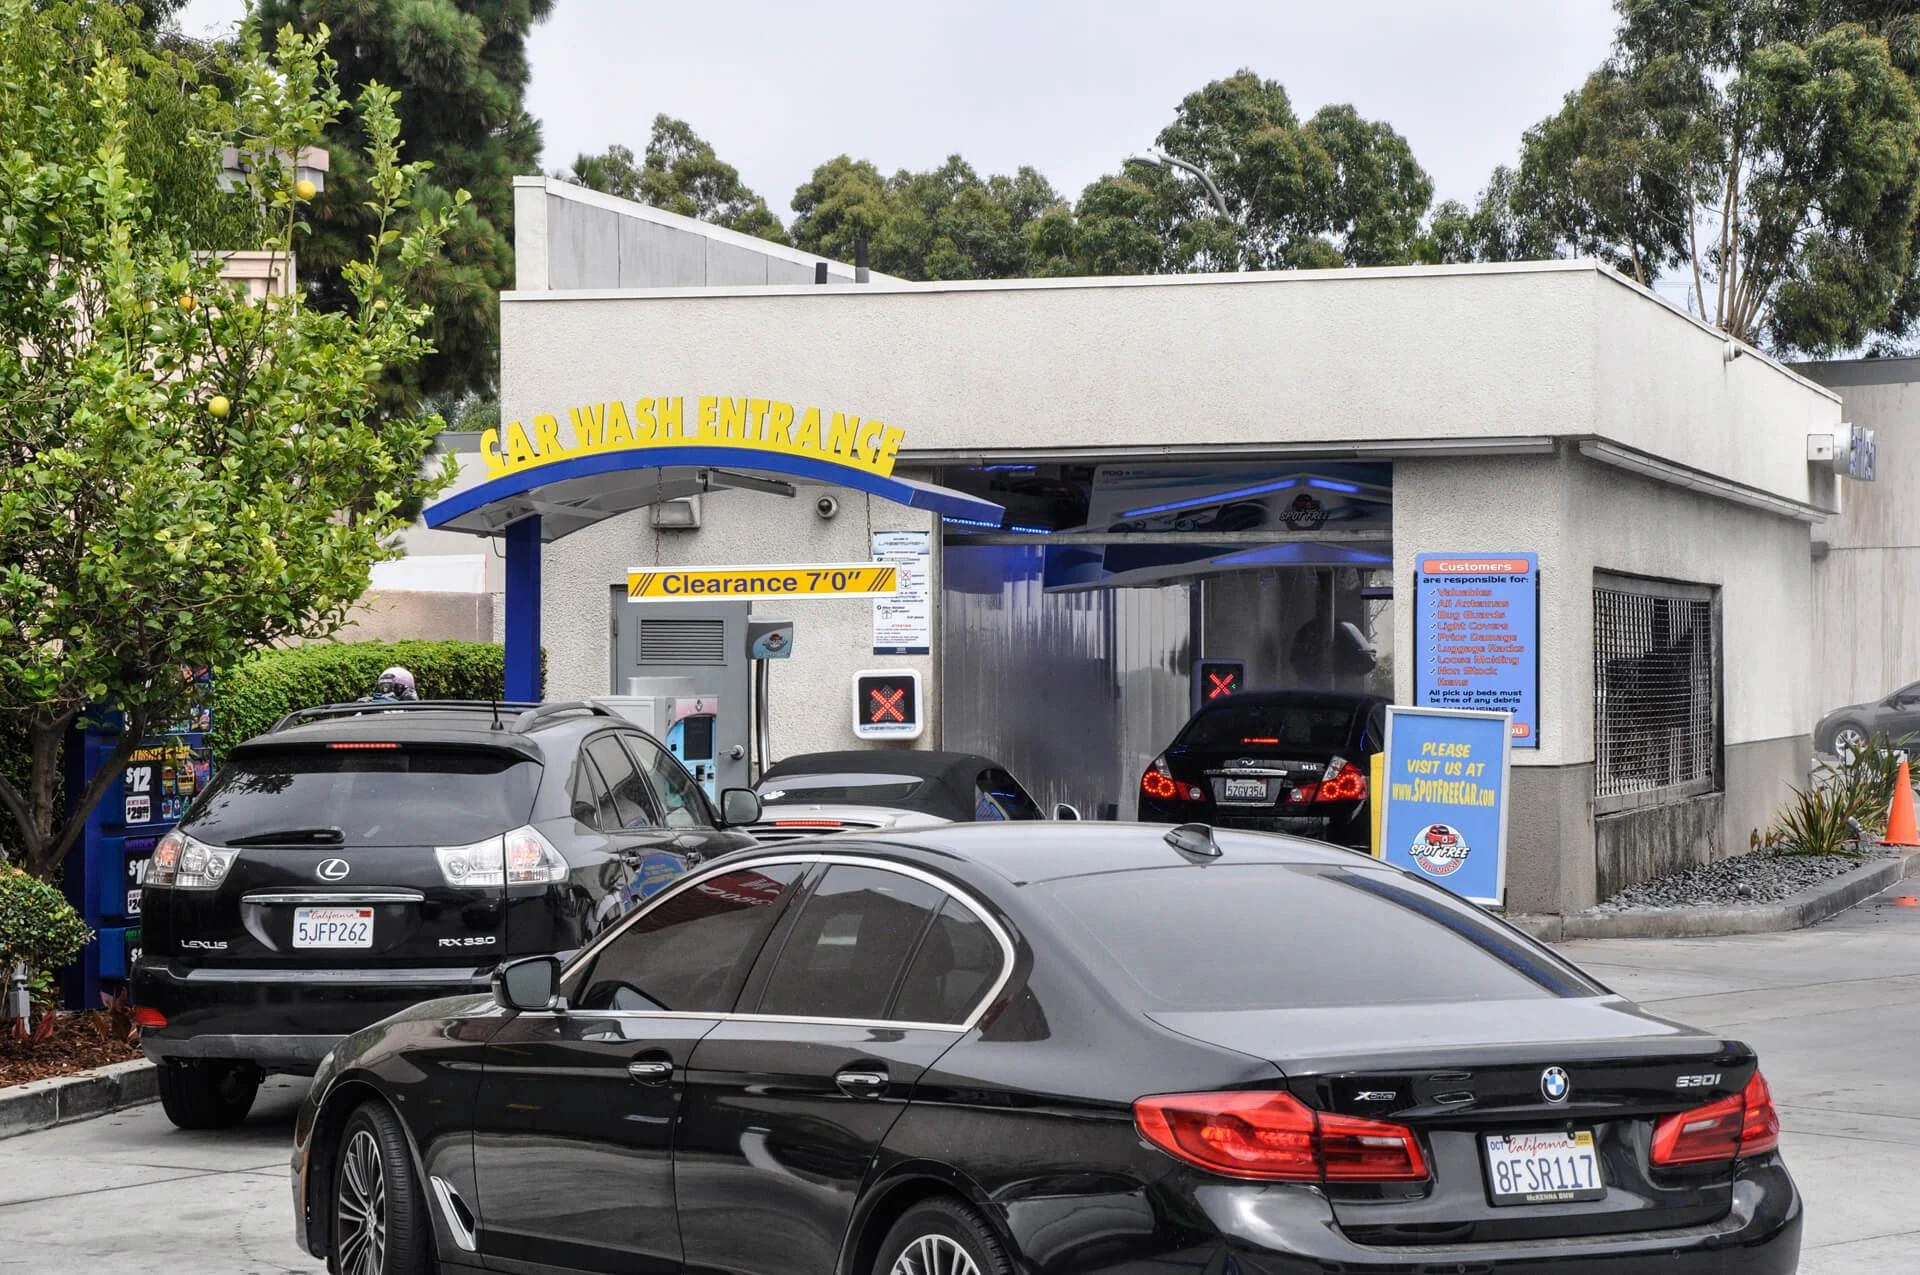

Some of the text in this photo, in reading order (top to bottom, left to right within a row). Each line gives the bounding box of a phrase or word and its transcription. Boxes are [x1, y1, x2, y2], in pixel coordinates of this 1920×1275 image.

[480, 395, 906, 475] CAR WASH ENTRANCE
[1439, 562, 1512, 571] Customers
[662, 574, 798, 594] Clearance
[1444, 576, 1506, 585] responsible
[1438, 610, 1505, 620] Bug Guards
[1438, 622, 1509, 632] Light Covers
[1438, 633, 1517, 643] Prior Damage
[1438, 644, 1525, 654] Luggage Racks
[1438, 655, 1520, 665] Loose Molding
[1438, 666, 1498, 675] Non Stock
[1442, 689, 1460, 697] pick
[1422, 742, 1471, 758] PLEASE
[1407, 759, 1485, 777] VISIT US AT
[126, 766, 151, 792] $12
[1409, 844, 1471, 859] SPOT FREE
[310, 910, 359, 922] California
[299, 922, 368, 942] 5JFP262
[181, 939, 228, 949] LEXUS
[439, 936, 496, 947] RX 330
[1490, 1141, 1505, 1150] OCT
[1508, 1136, 1575, 1156] California
[1497, 1155, 1593, 1193] 8FSR117
